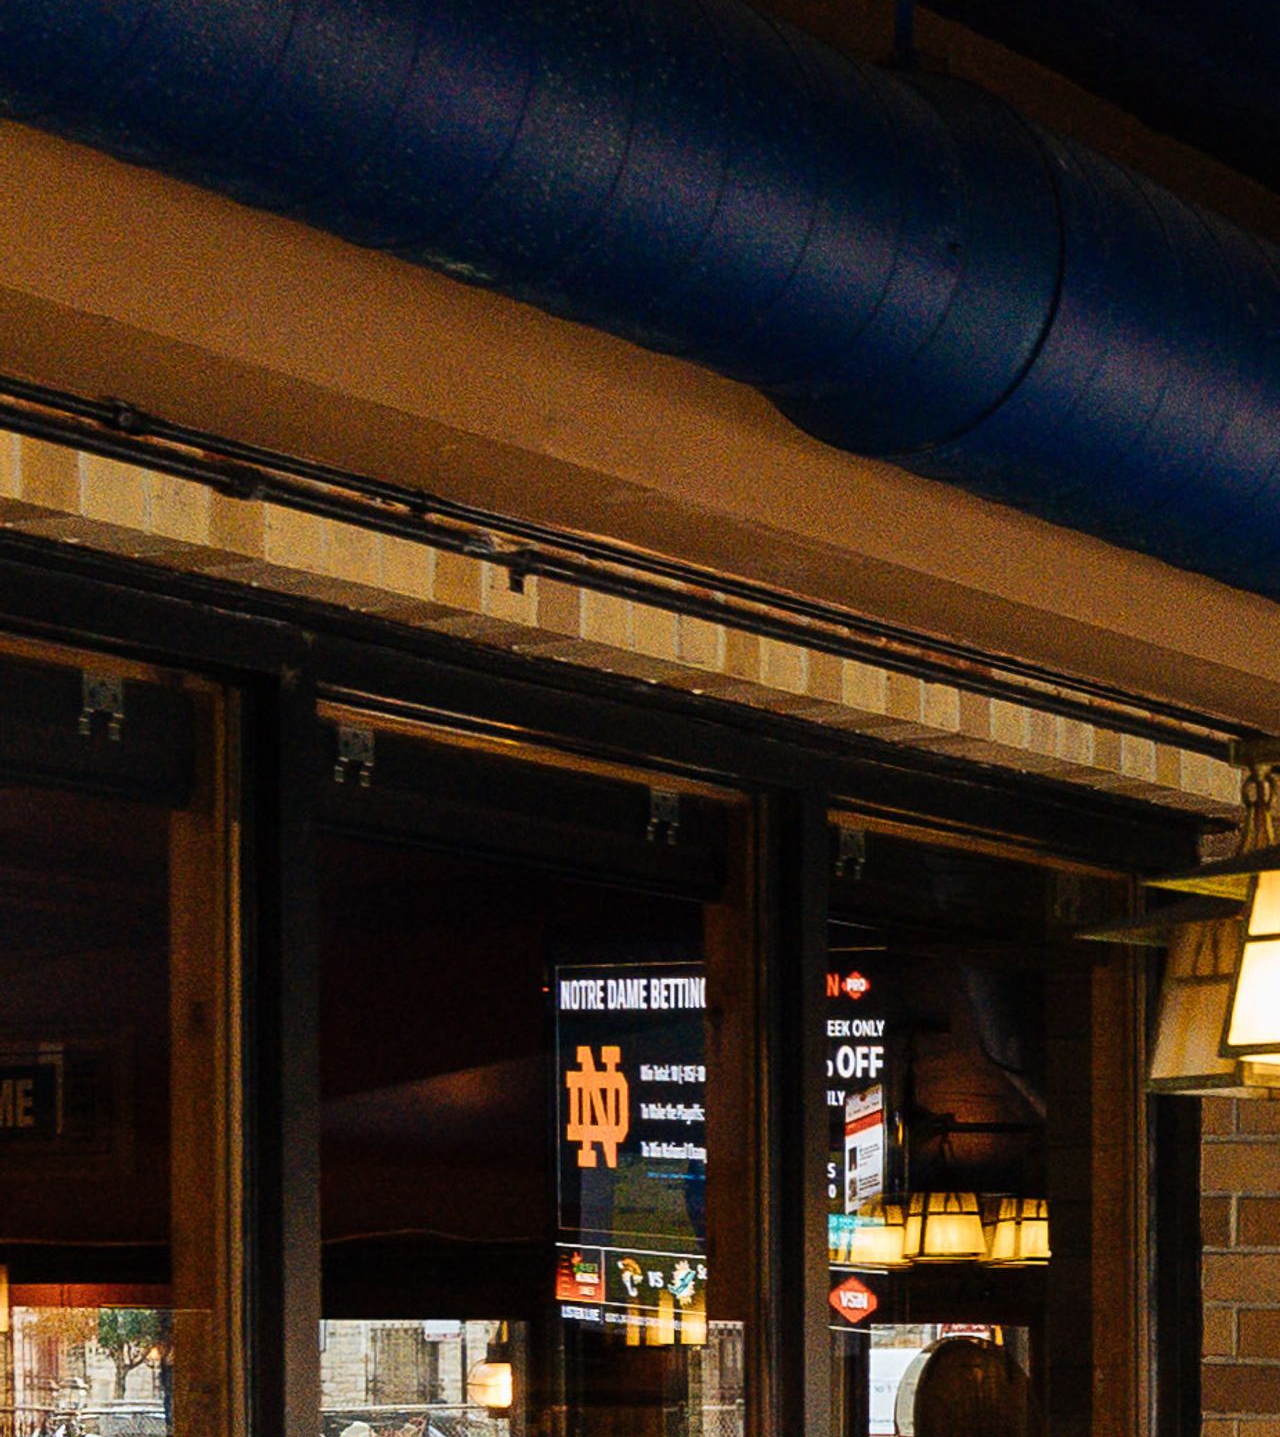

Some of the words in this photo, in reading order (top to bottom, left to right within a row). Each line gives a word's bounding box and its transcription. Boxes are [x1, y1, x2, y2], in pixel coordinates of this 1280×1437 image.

[560, 979, 604, 1010] NOTRE
[607, 978, 648, 1010] DAME
[852, 1019, 885, 1037] ONLY
[836, 1045, 884, 1079] OFF
